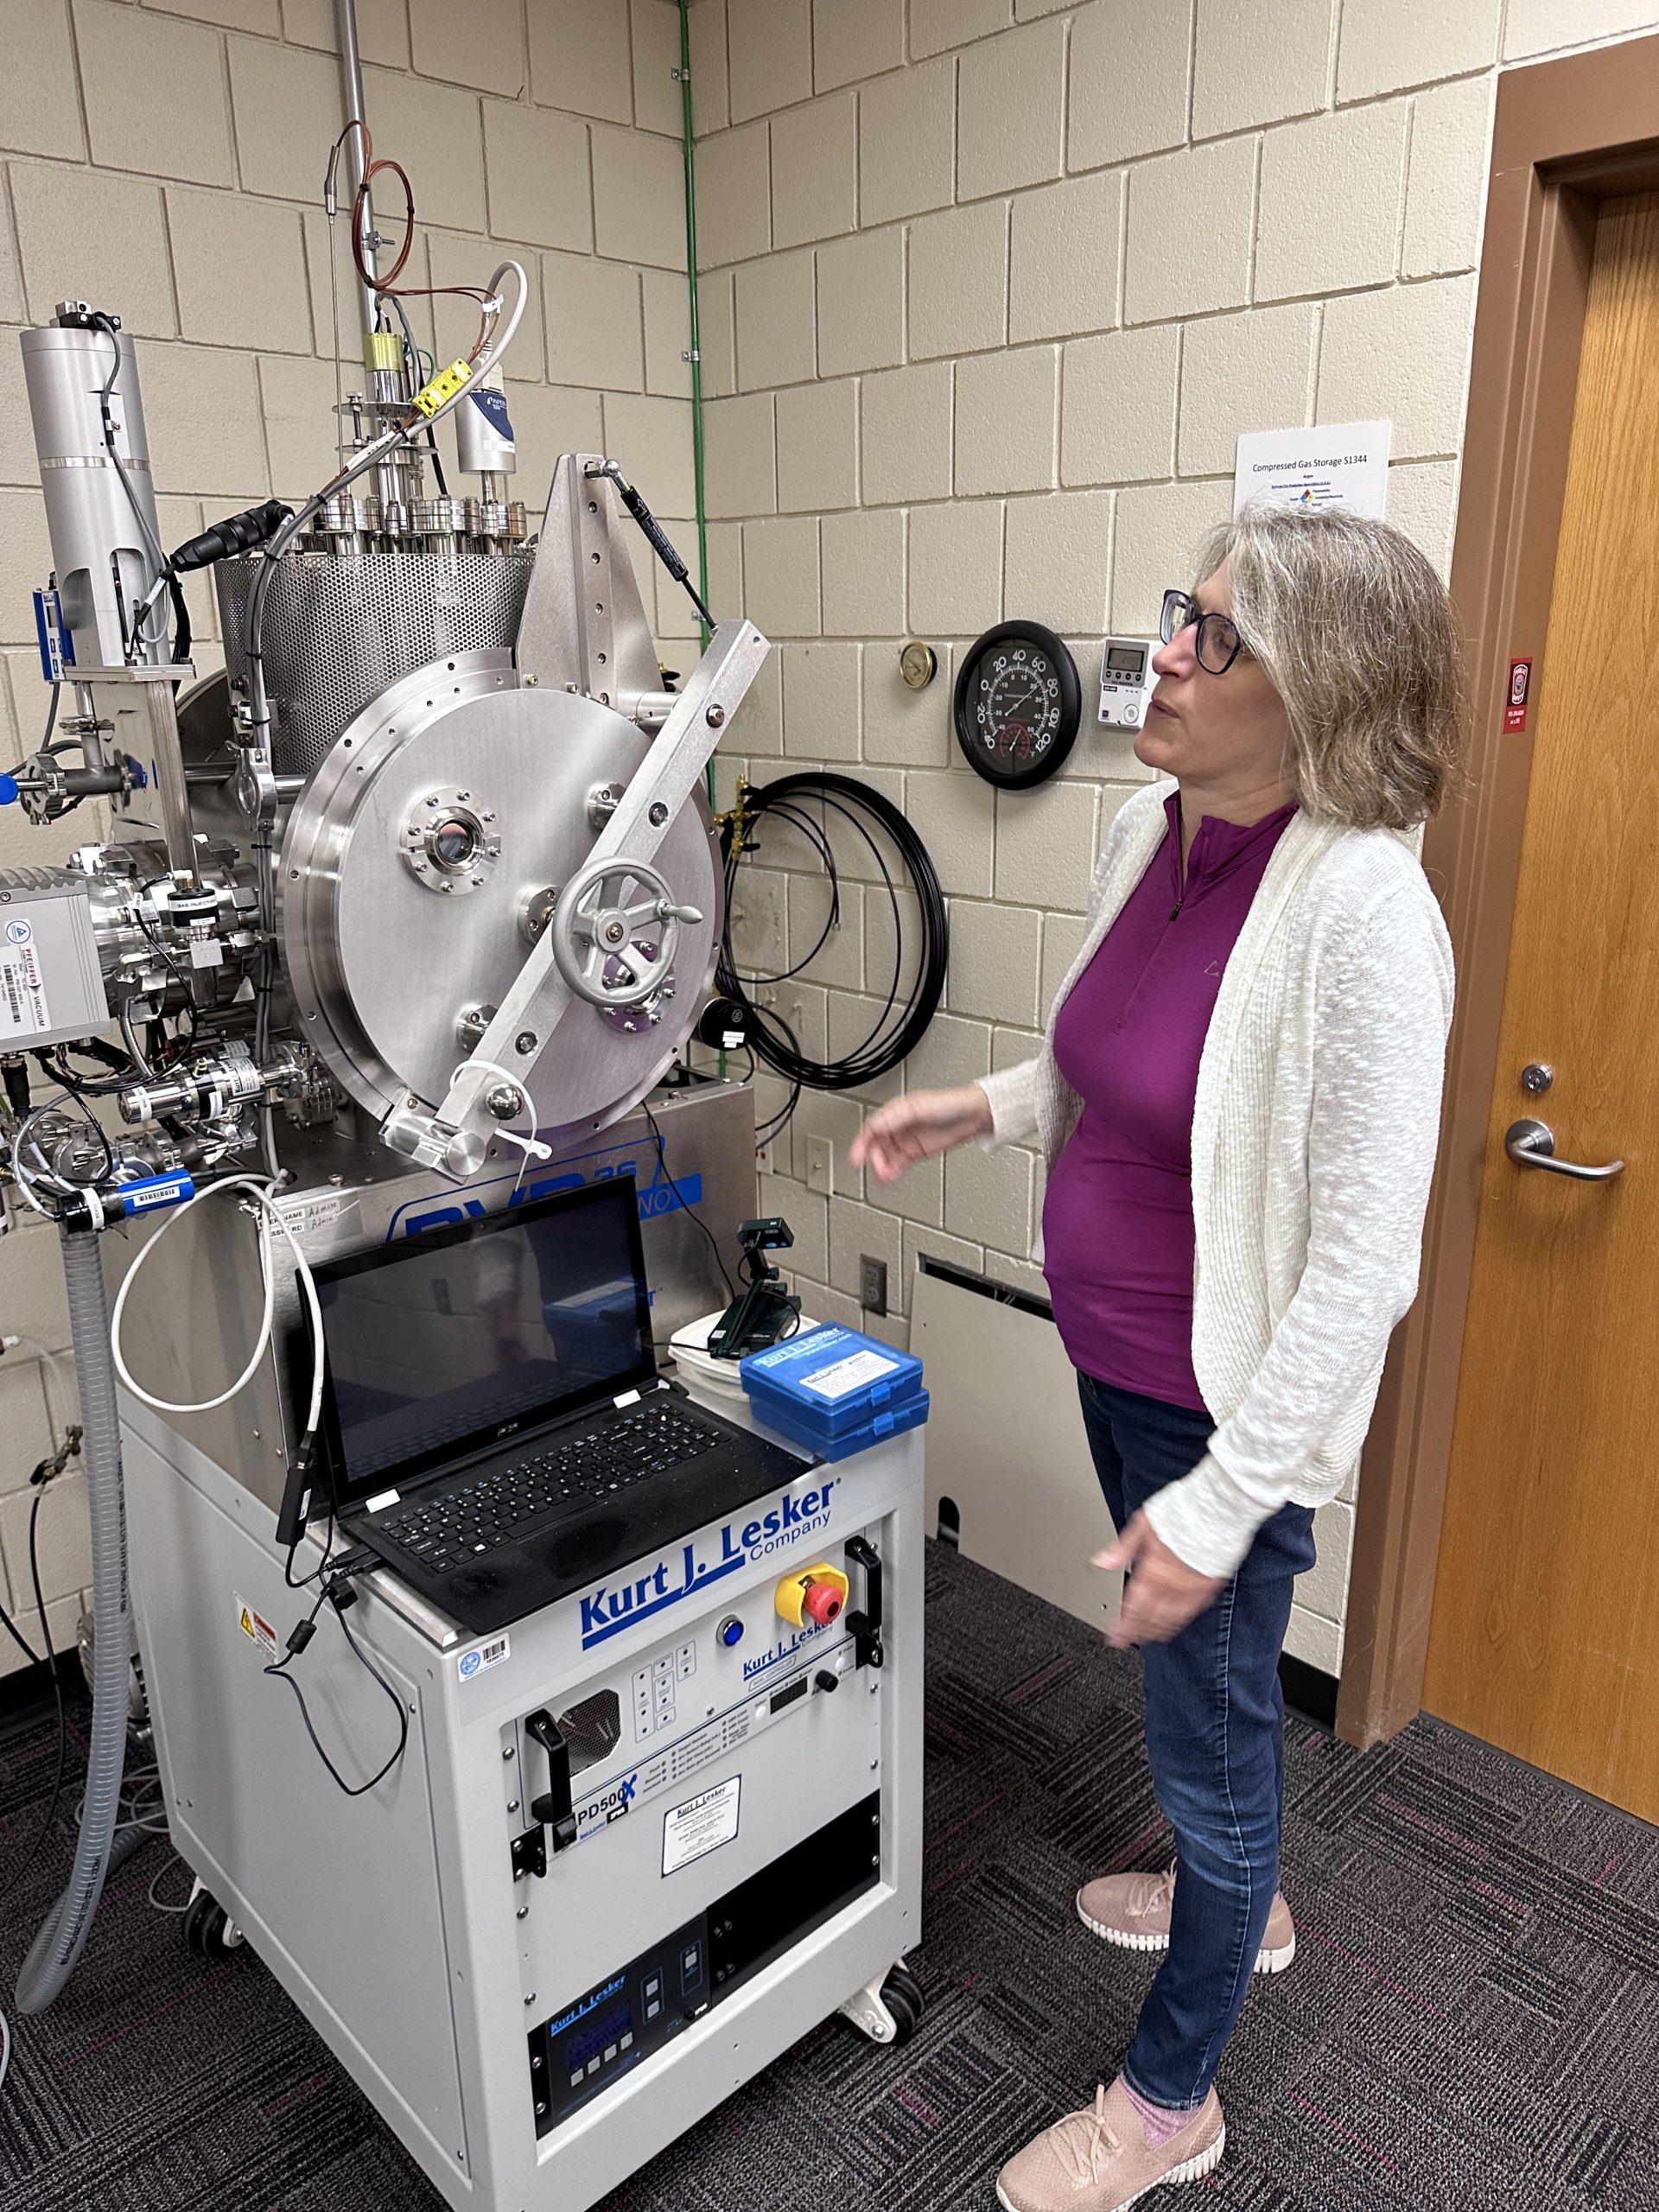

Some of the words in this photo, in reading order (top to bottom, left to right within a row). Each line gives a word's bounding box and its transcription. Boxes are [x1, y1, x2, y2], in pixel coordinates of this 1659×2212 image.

[1253, 461, 1296, 473] Compressed
[1299, 460, 1313, 468] Gas
[1313, 457, 1342, 467] Storage
[1344, 454, 1367, 465] S1344
[994, 657, 1007, 672] 20
[1013, 650, 1026, 661] 40
[1032, 657, 1046, 672] 60
[981, 679, 988, 690] 0
[1047, 678, 1058, 697] 80
[1048, 708, 1060, 728] 100
[1035, 733, 1051, 753] 120
[26, 949, 37, 984] PFEIFFER
[34, 996, 45, 1027] VACUUM
[498, 1423, 518, 1437] acer
[750, 1510, 831, 1560] Company
[579, 1562, 669, 1635] Kurt
[681, 1543, 707, 1595] J.
[721, 1481, 835, 1560] Lesker
[802, 1624, 834, 1647] Company
[743, 1649, 773, 1675] Kurt
[550, 2011, 575, 2033] Kurt
[589, 1975, 626, 2005] Lesker
